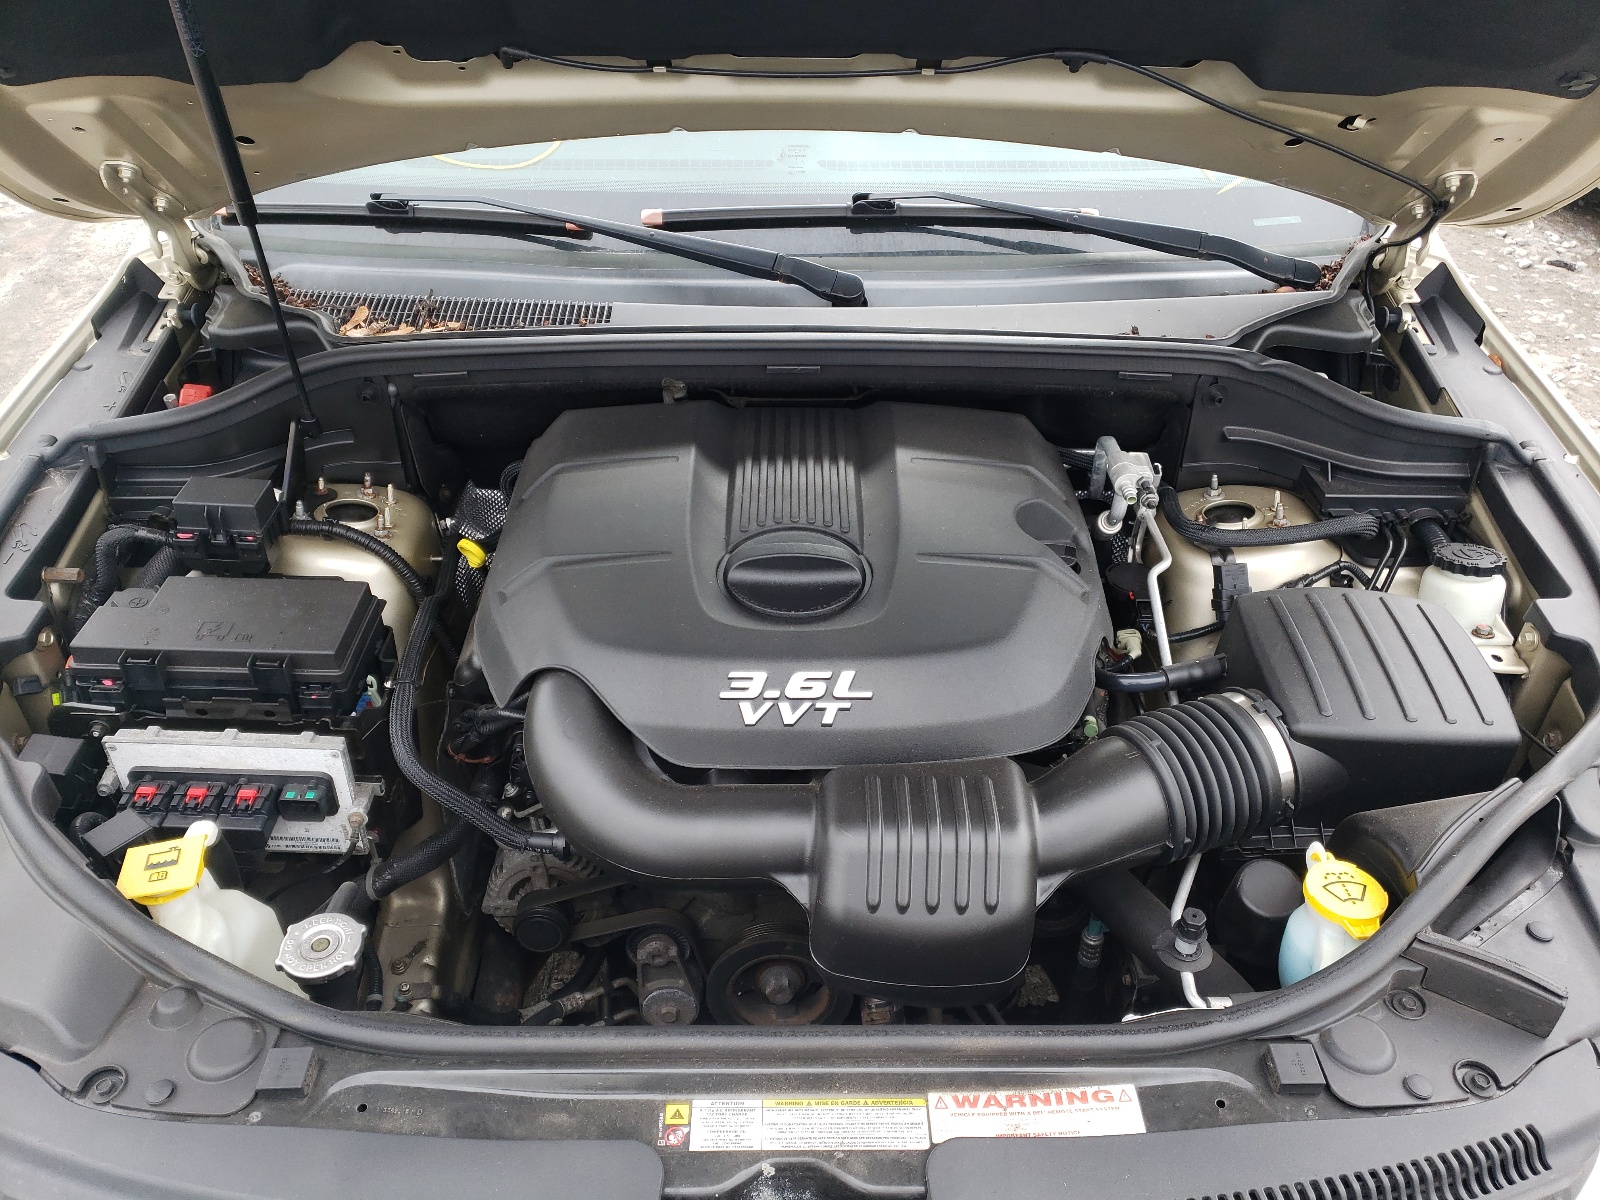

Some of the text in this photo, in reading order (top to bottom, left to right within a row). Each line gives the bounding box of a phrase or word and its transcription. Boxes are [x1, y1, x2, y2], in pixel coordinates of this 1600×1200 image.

[719, 670, 873, 700] 3.6L
[738, 702, 852, 727] VVT
[299, 962, 328, 971] OPEN
[951, 1089, 1115, 1109] WARNING
